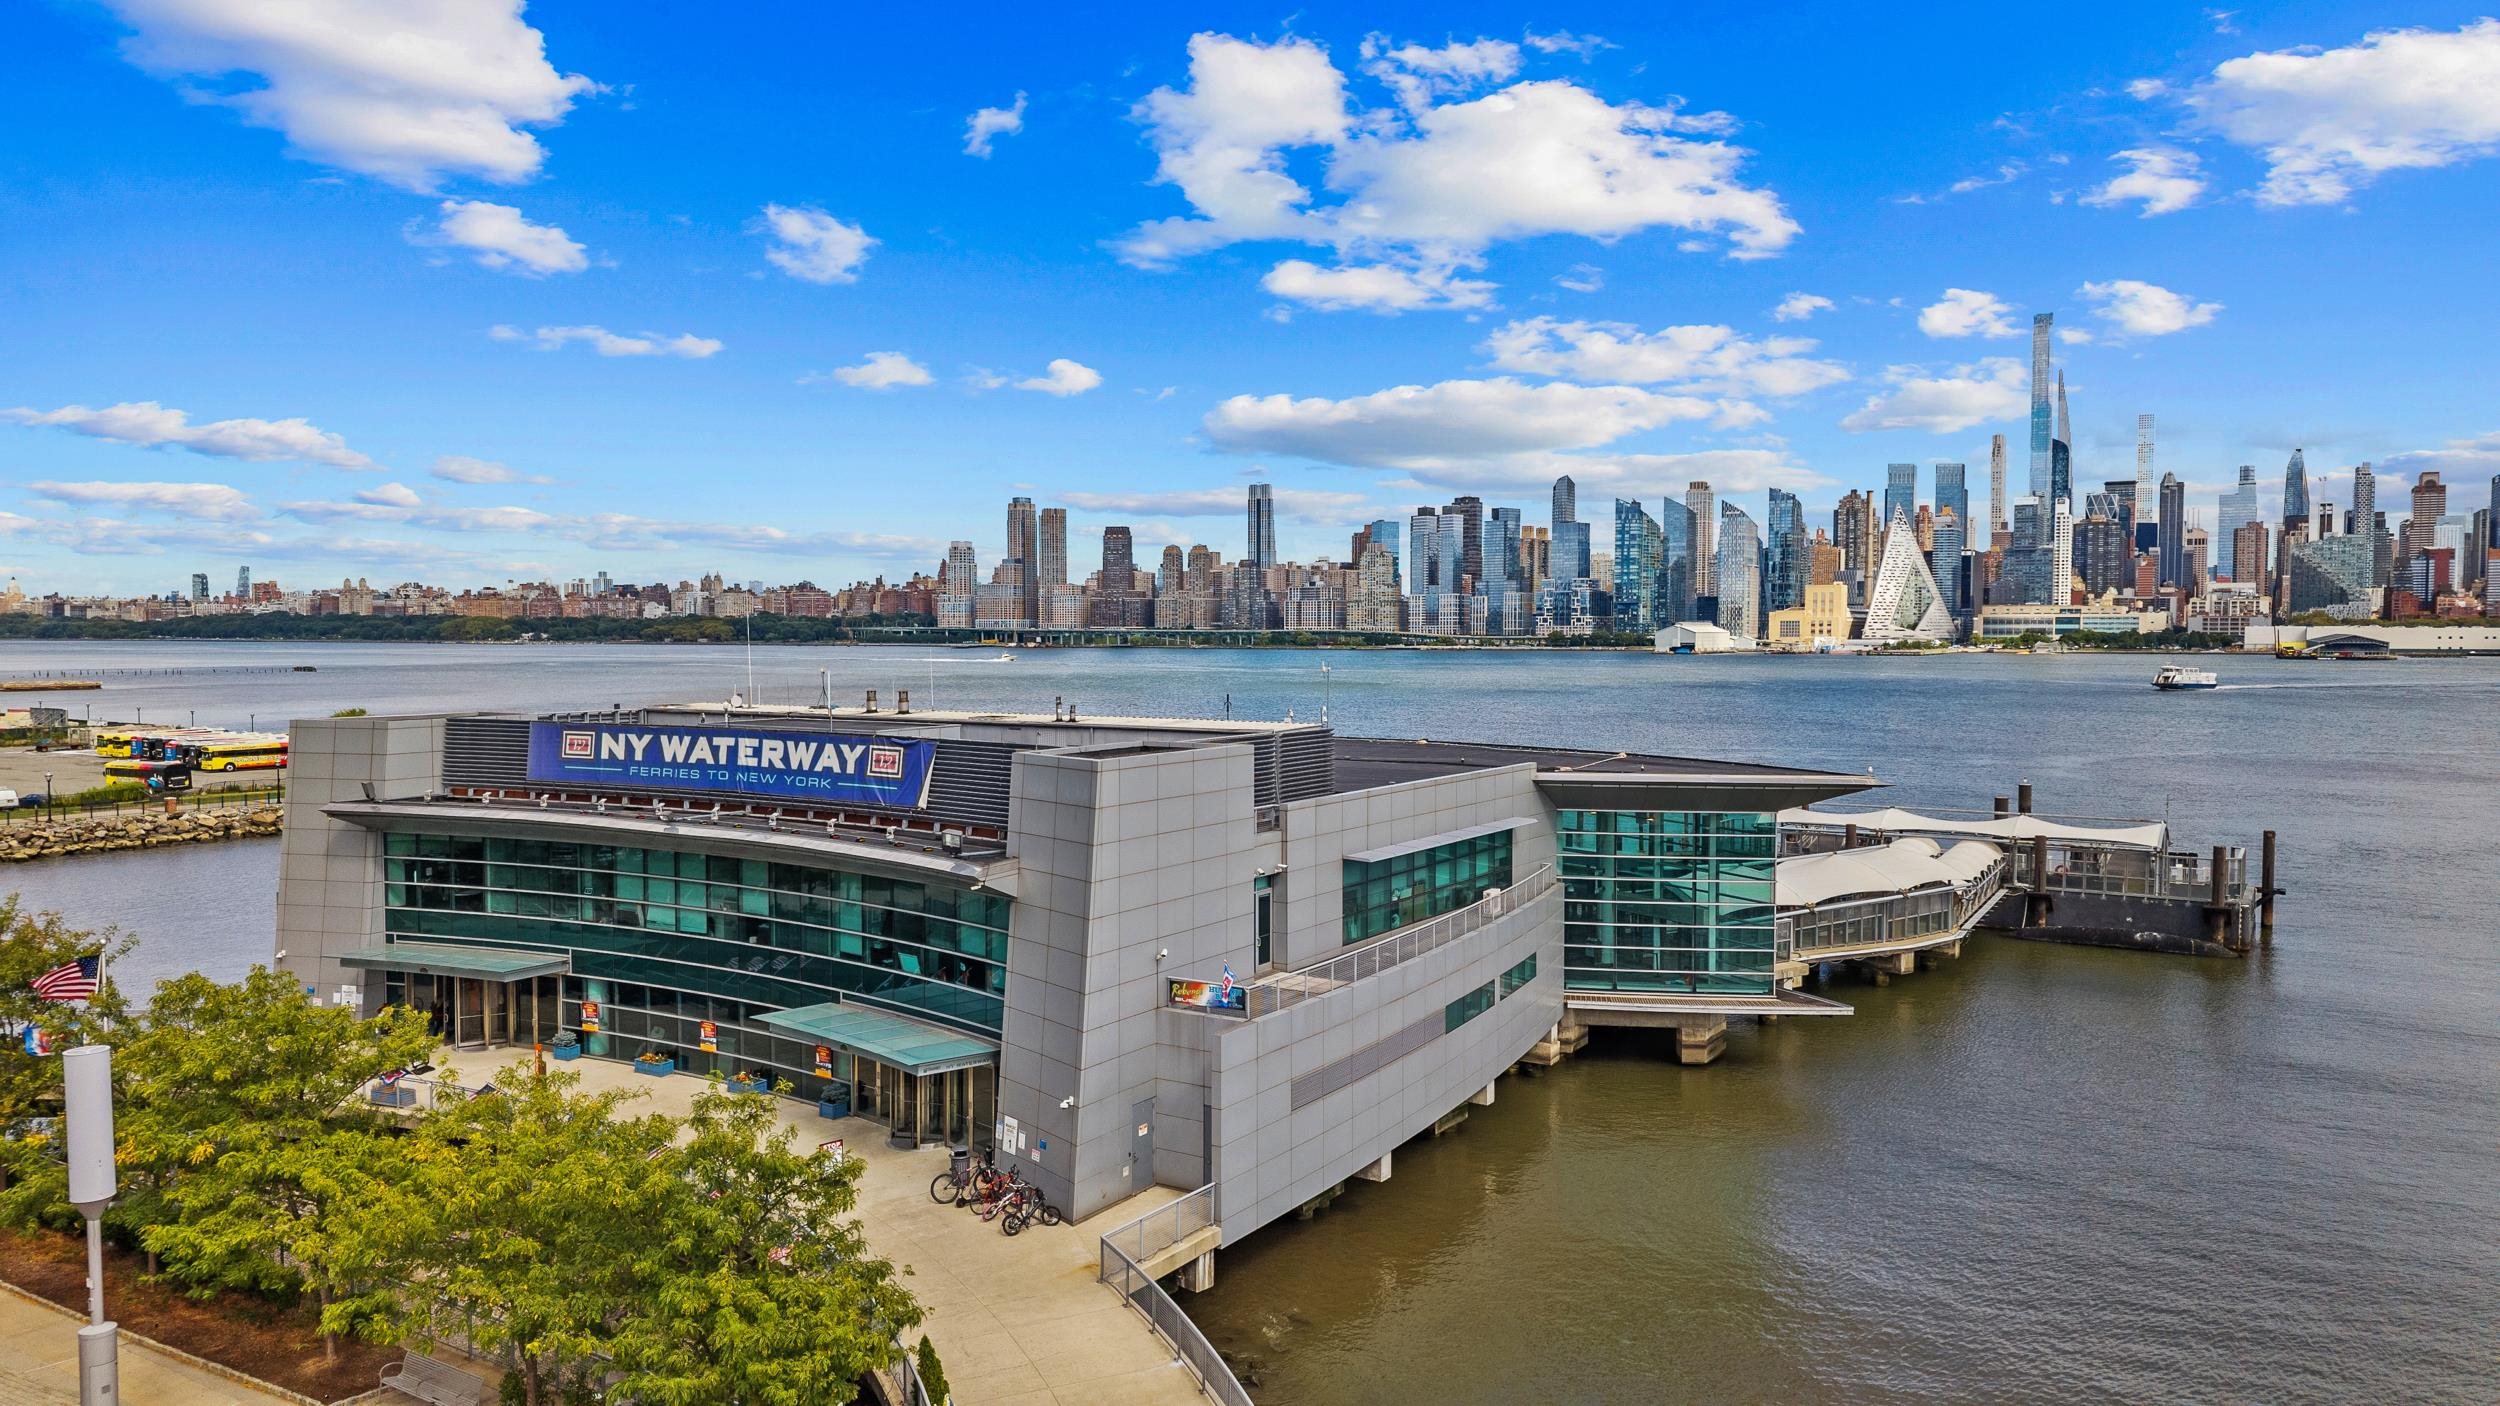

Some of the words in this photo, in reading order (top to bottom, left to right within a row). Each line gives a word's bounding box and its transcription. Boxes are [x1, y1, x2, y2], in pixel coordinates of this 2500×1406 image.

[601, 732, 653, 761] NY
[660, 734, 866, 775] WATERWAY
[629, 766, 700, 780] FERRIES
[707, 770, 729, 781] TO
[736, 772, 777, 784] NEW
[784, 775, 832, 789] YORK
